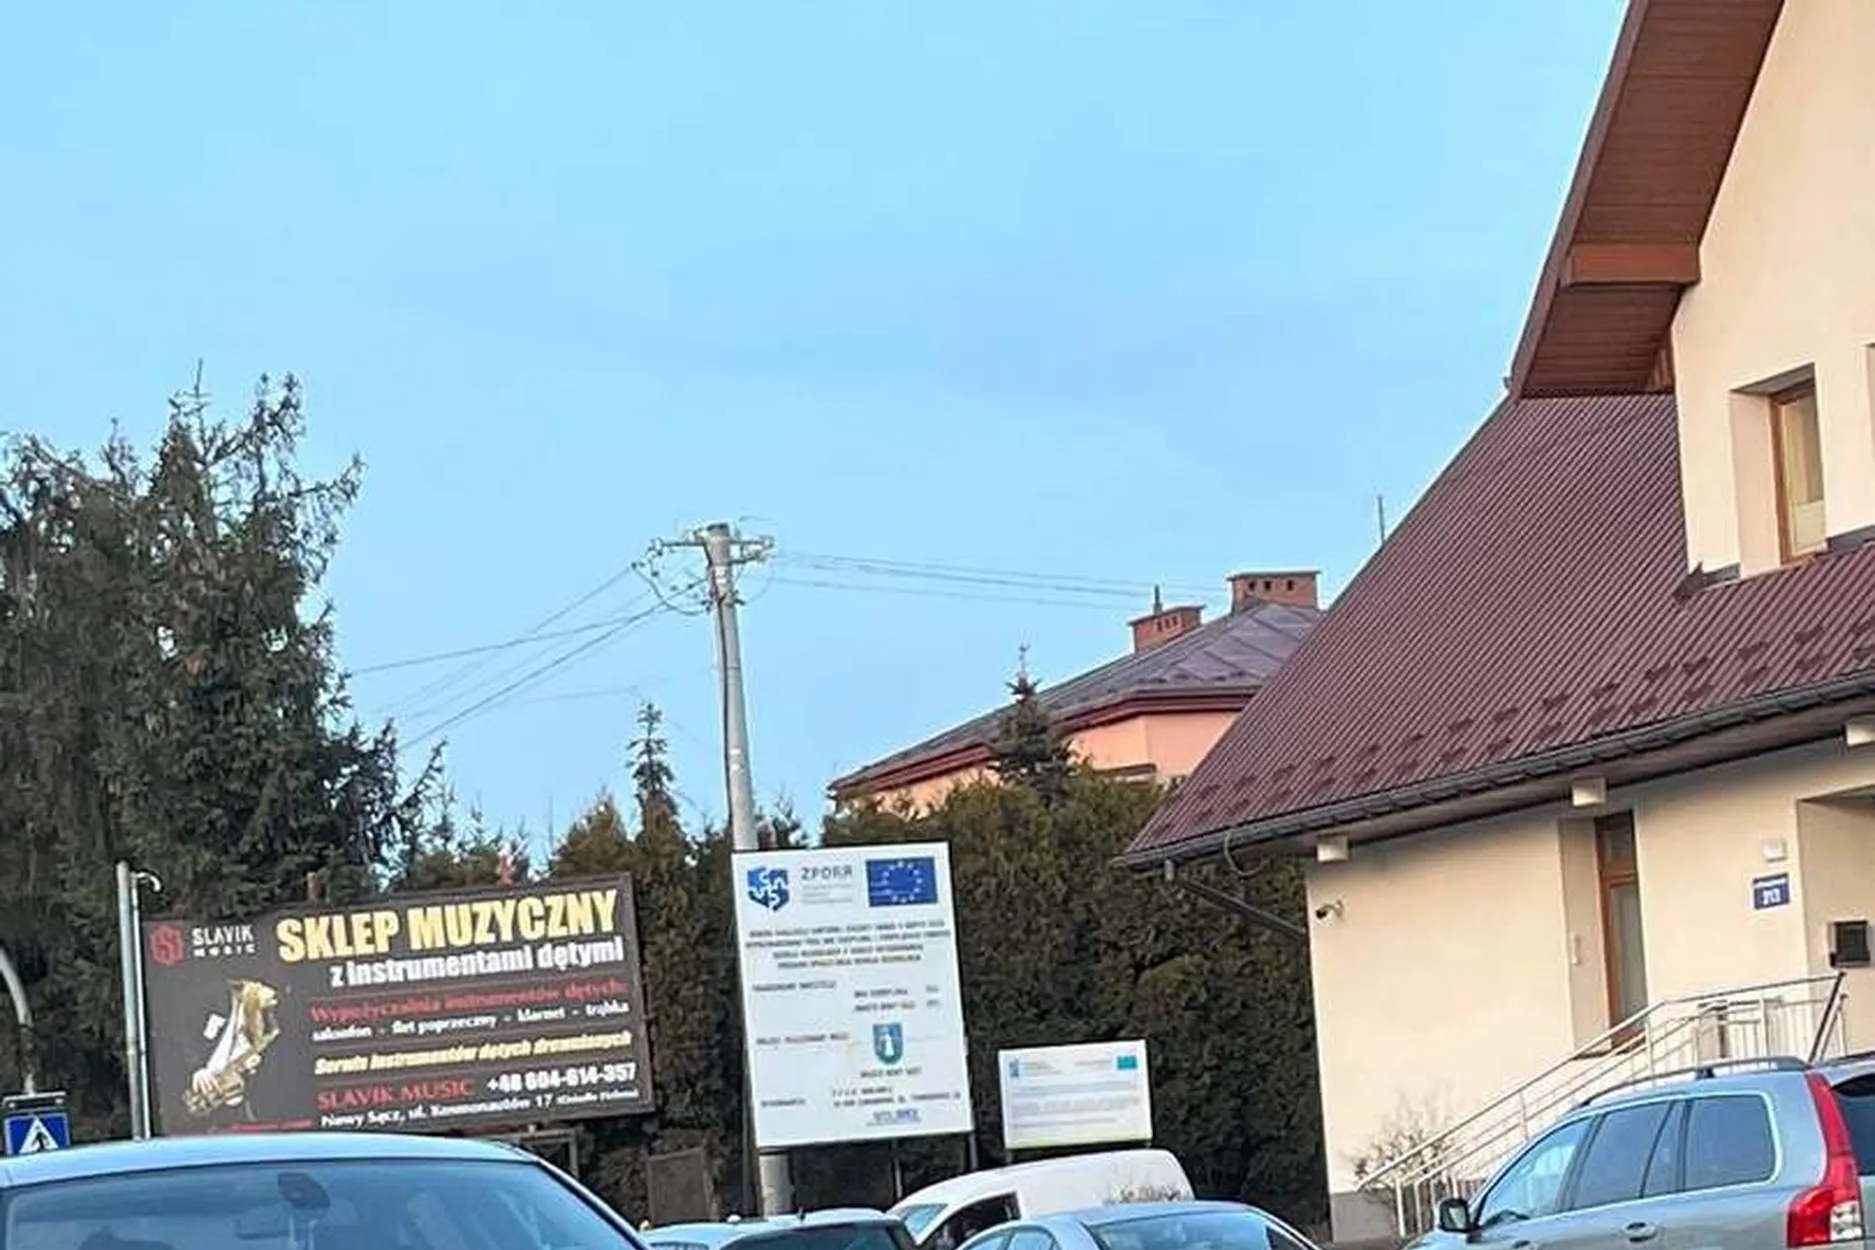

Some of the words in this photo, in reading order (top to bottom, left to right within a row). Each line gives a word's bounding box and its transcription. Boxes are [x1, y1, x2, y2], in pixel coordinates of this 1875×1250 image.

[192, 925, 254, 946] SLAVIK
[276, 910, 400, 962] SKLEP
[407, 889, 617, 950] MUZYCZNY
[330, 965, 344, 987] z
[346, 945, 534, 985] instrumentami
[537, 936, 625, 971] dętymi
[317, 1085, 394, 1111] SLAVIK
[400, 1079, 475, 1099] MUSIC
